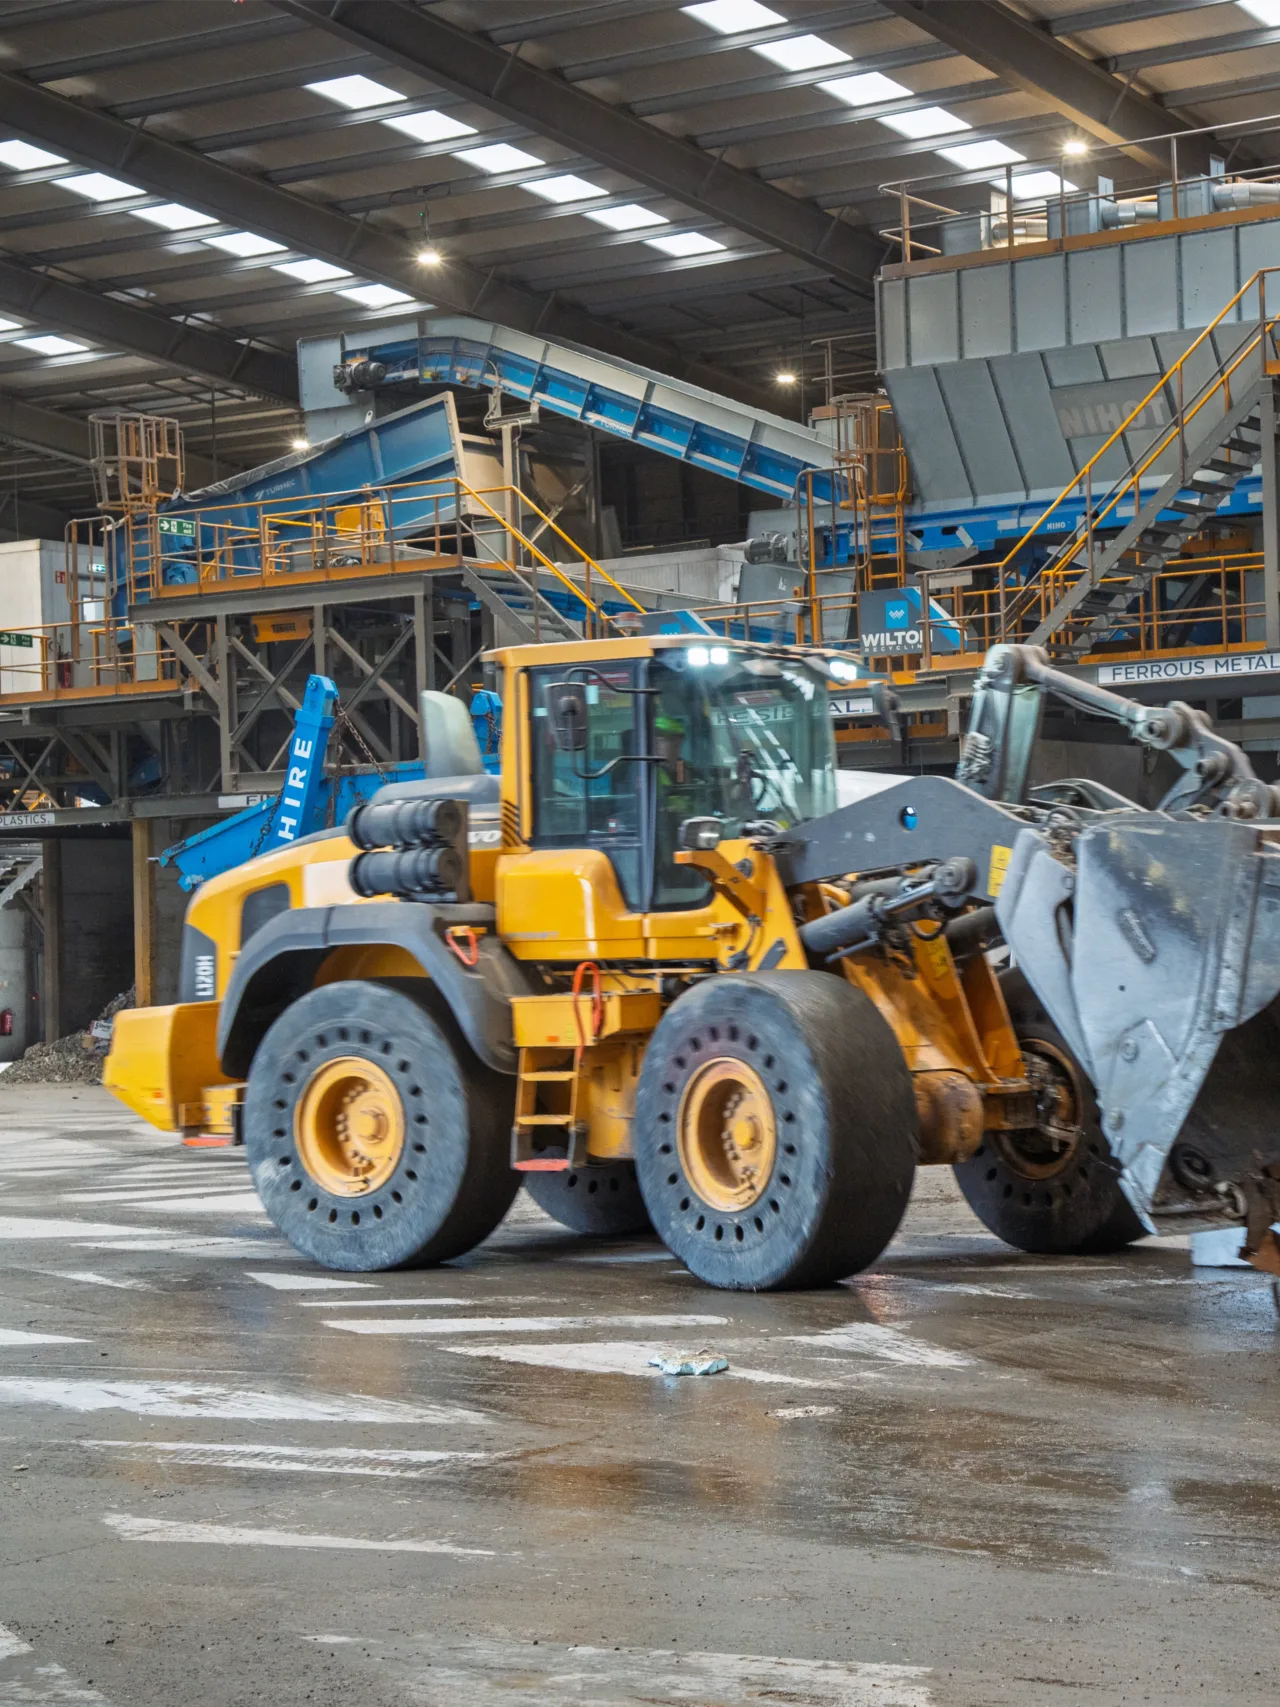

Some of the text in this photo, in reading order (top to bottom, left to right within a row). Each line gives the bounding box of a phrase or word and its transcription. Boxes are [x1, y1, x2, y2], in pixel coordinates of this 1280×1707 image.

[1058, 397, 1165, 439] NIHOT
[865, 643, 923, 652] RECYCLIN
[1112, 655, 1280, 681] FERROUS METAL
[278, 738, 313, 840] HIRE
[195, 955, 214, 996] L120H
